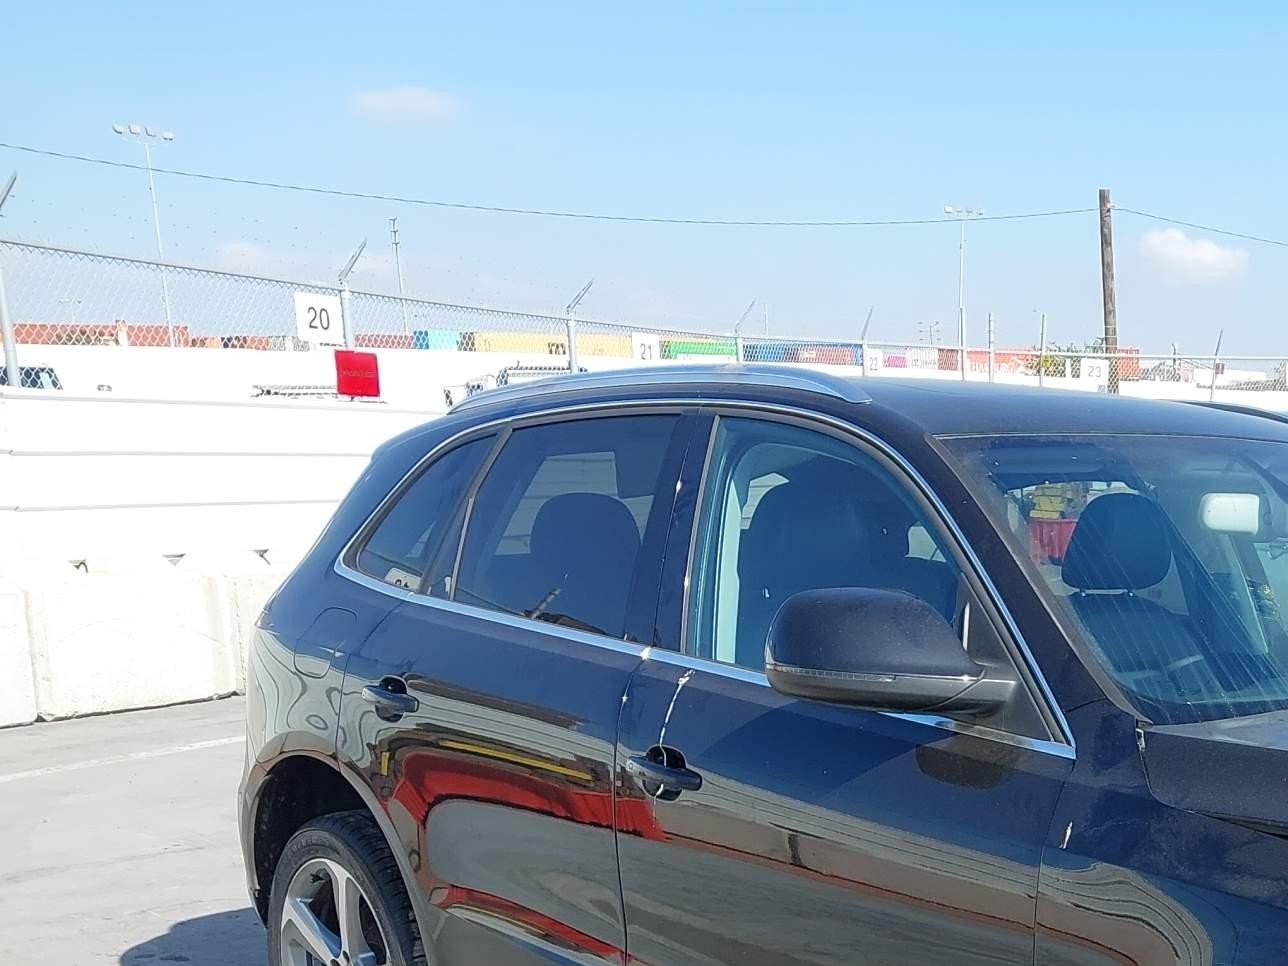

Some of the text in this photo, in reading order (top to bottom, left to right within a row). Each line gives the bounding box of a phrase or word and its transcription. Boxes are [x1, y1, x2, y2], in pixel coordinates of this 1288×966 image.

[307, 306, 330, 331] 20
[640, 342, 652, 360] 21
[869, 356, 879, 371] 22
[1087, 365, 1102, 378] 23
